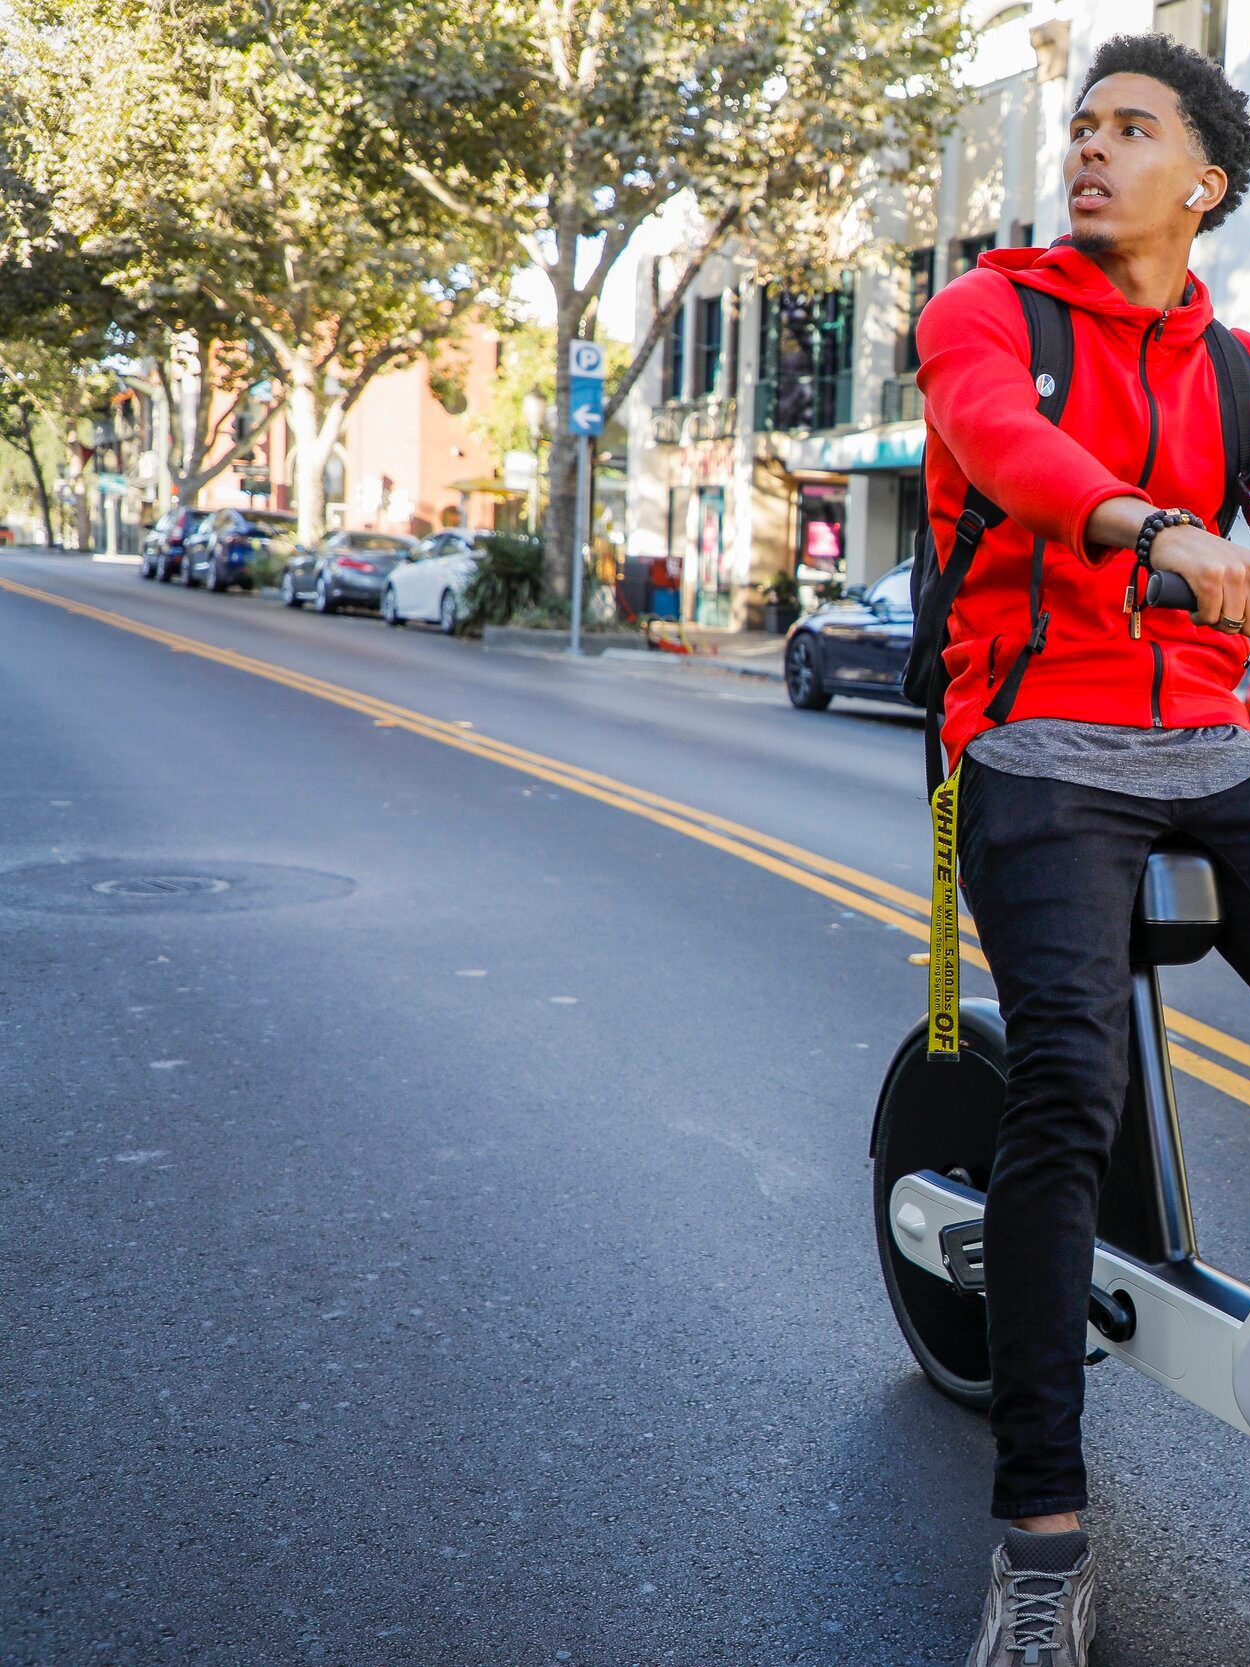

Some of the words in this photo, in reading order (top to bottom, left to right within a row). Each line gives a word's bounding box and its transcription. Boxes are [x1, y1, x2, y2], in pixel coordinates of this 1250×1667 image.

[936, 789, 954, 884] WHITE
[944, 909, 954, 942] WILL
[943, 948, 955, 983] 5,400
[935, 1012, 954, 1052] OF
